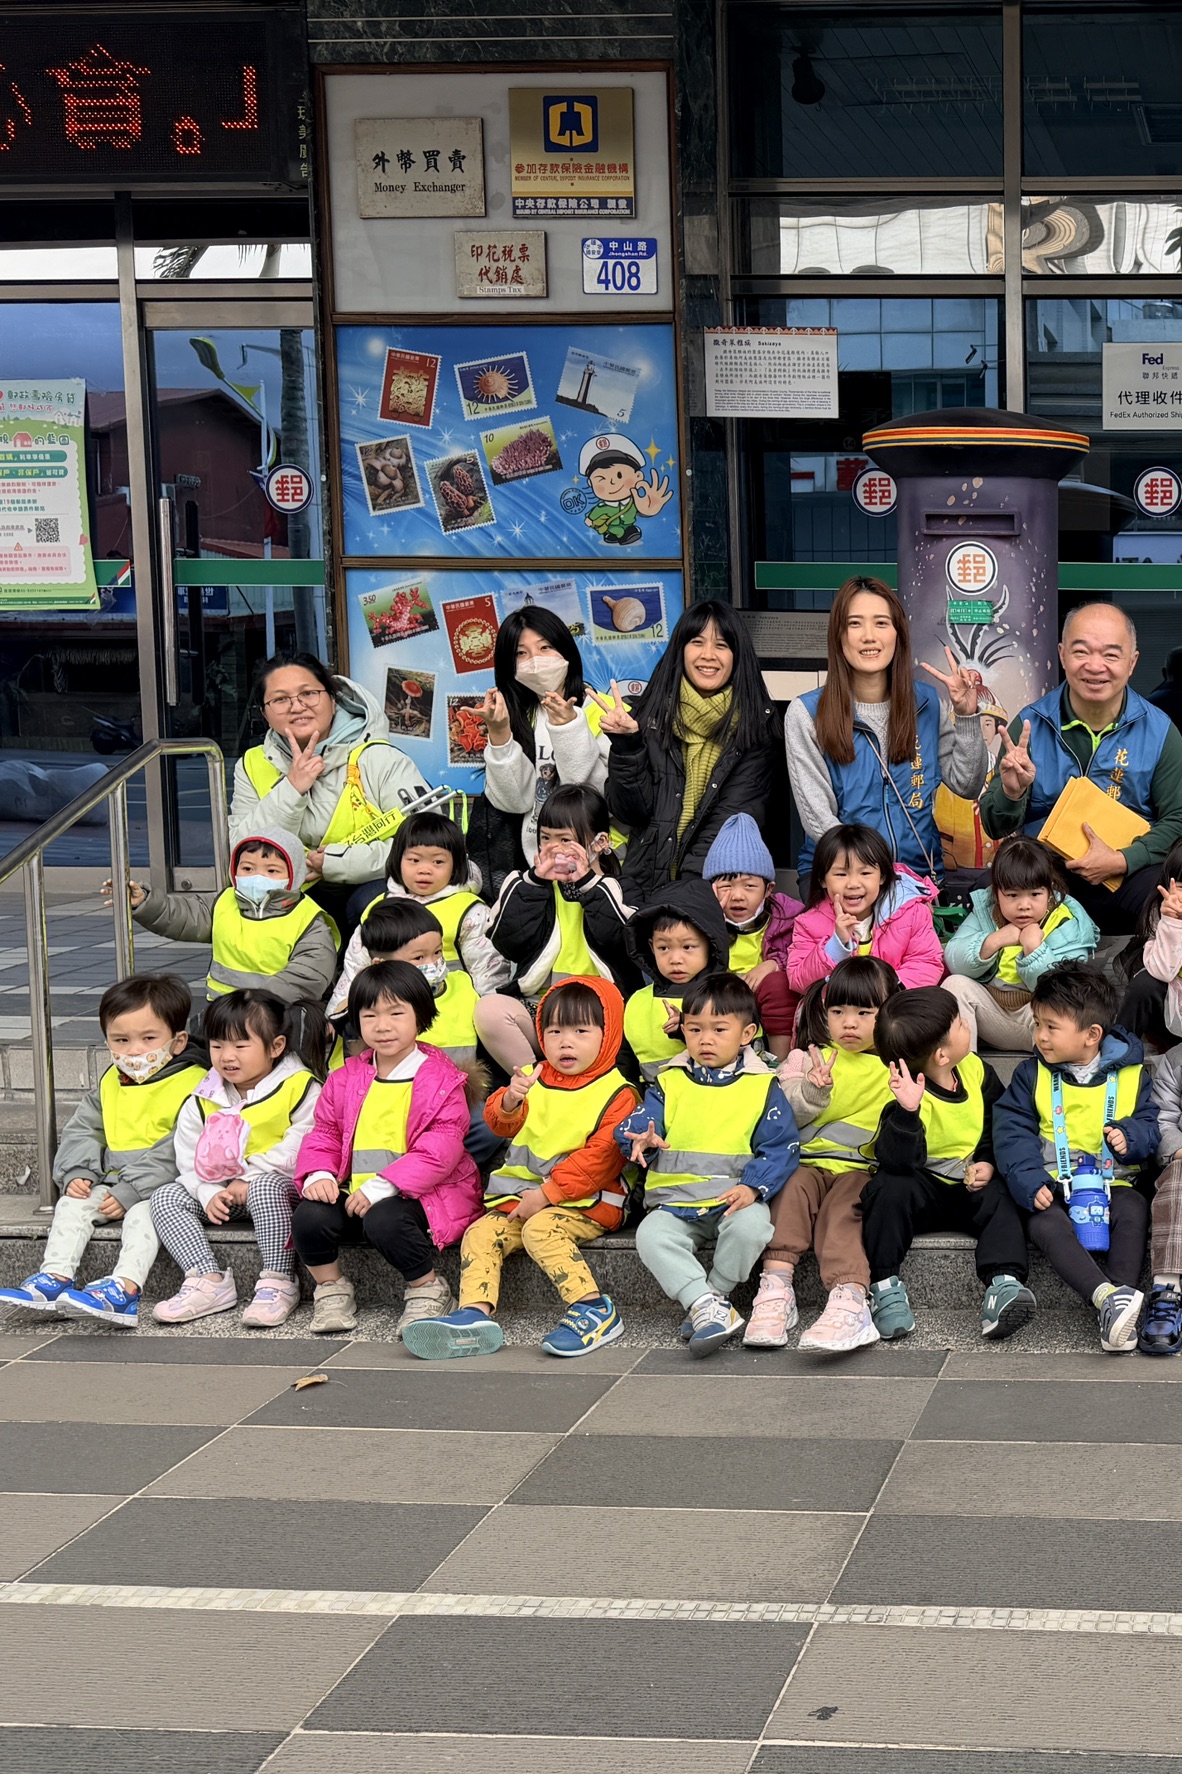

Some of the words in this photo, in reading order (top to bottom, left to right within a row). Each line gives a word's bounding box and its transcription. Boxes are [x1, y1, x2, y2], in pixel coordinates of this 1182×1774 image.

[372, 148, 467, 174] 外幣買賣
[514, 163, 629, 174] 參加存款保險金融機構
[374, 182, 406, 194] Money
[413, 181, 466, 193] Exchanger
[515, 198, 600, 209] 中央存款保險公司
[609, 240, 647, 251] 中山路
[478, 264, 525, 285] 代銷處
[597, 260, 641, 291] 408
[425, 357, 436, 368] 12
[1142, 352, 1164, 365] Fed
[466, 401, 481, 415] 12
[616, 408, 627, 418] 5
[484, 433, 495, 444] 10
[466, 455, 475, 464] 5
[275, 474, 304, 503] 郵
[862, 477, 892, 506] 郵
[1144, 478, 1173, 507] 郵
[562, 493, 585, 511] OK
[957, 554, 987, 584] 郵
[484, 597, 491, 608] 5
[650, 623, 664, 638] 12
[1106, 1096, 1115, 1122] FRIENDS
[1059, 1147, 1067, 1172] FRIENDS
[987, 1295, 998, 1310] N
